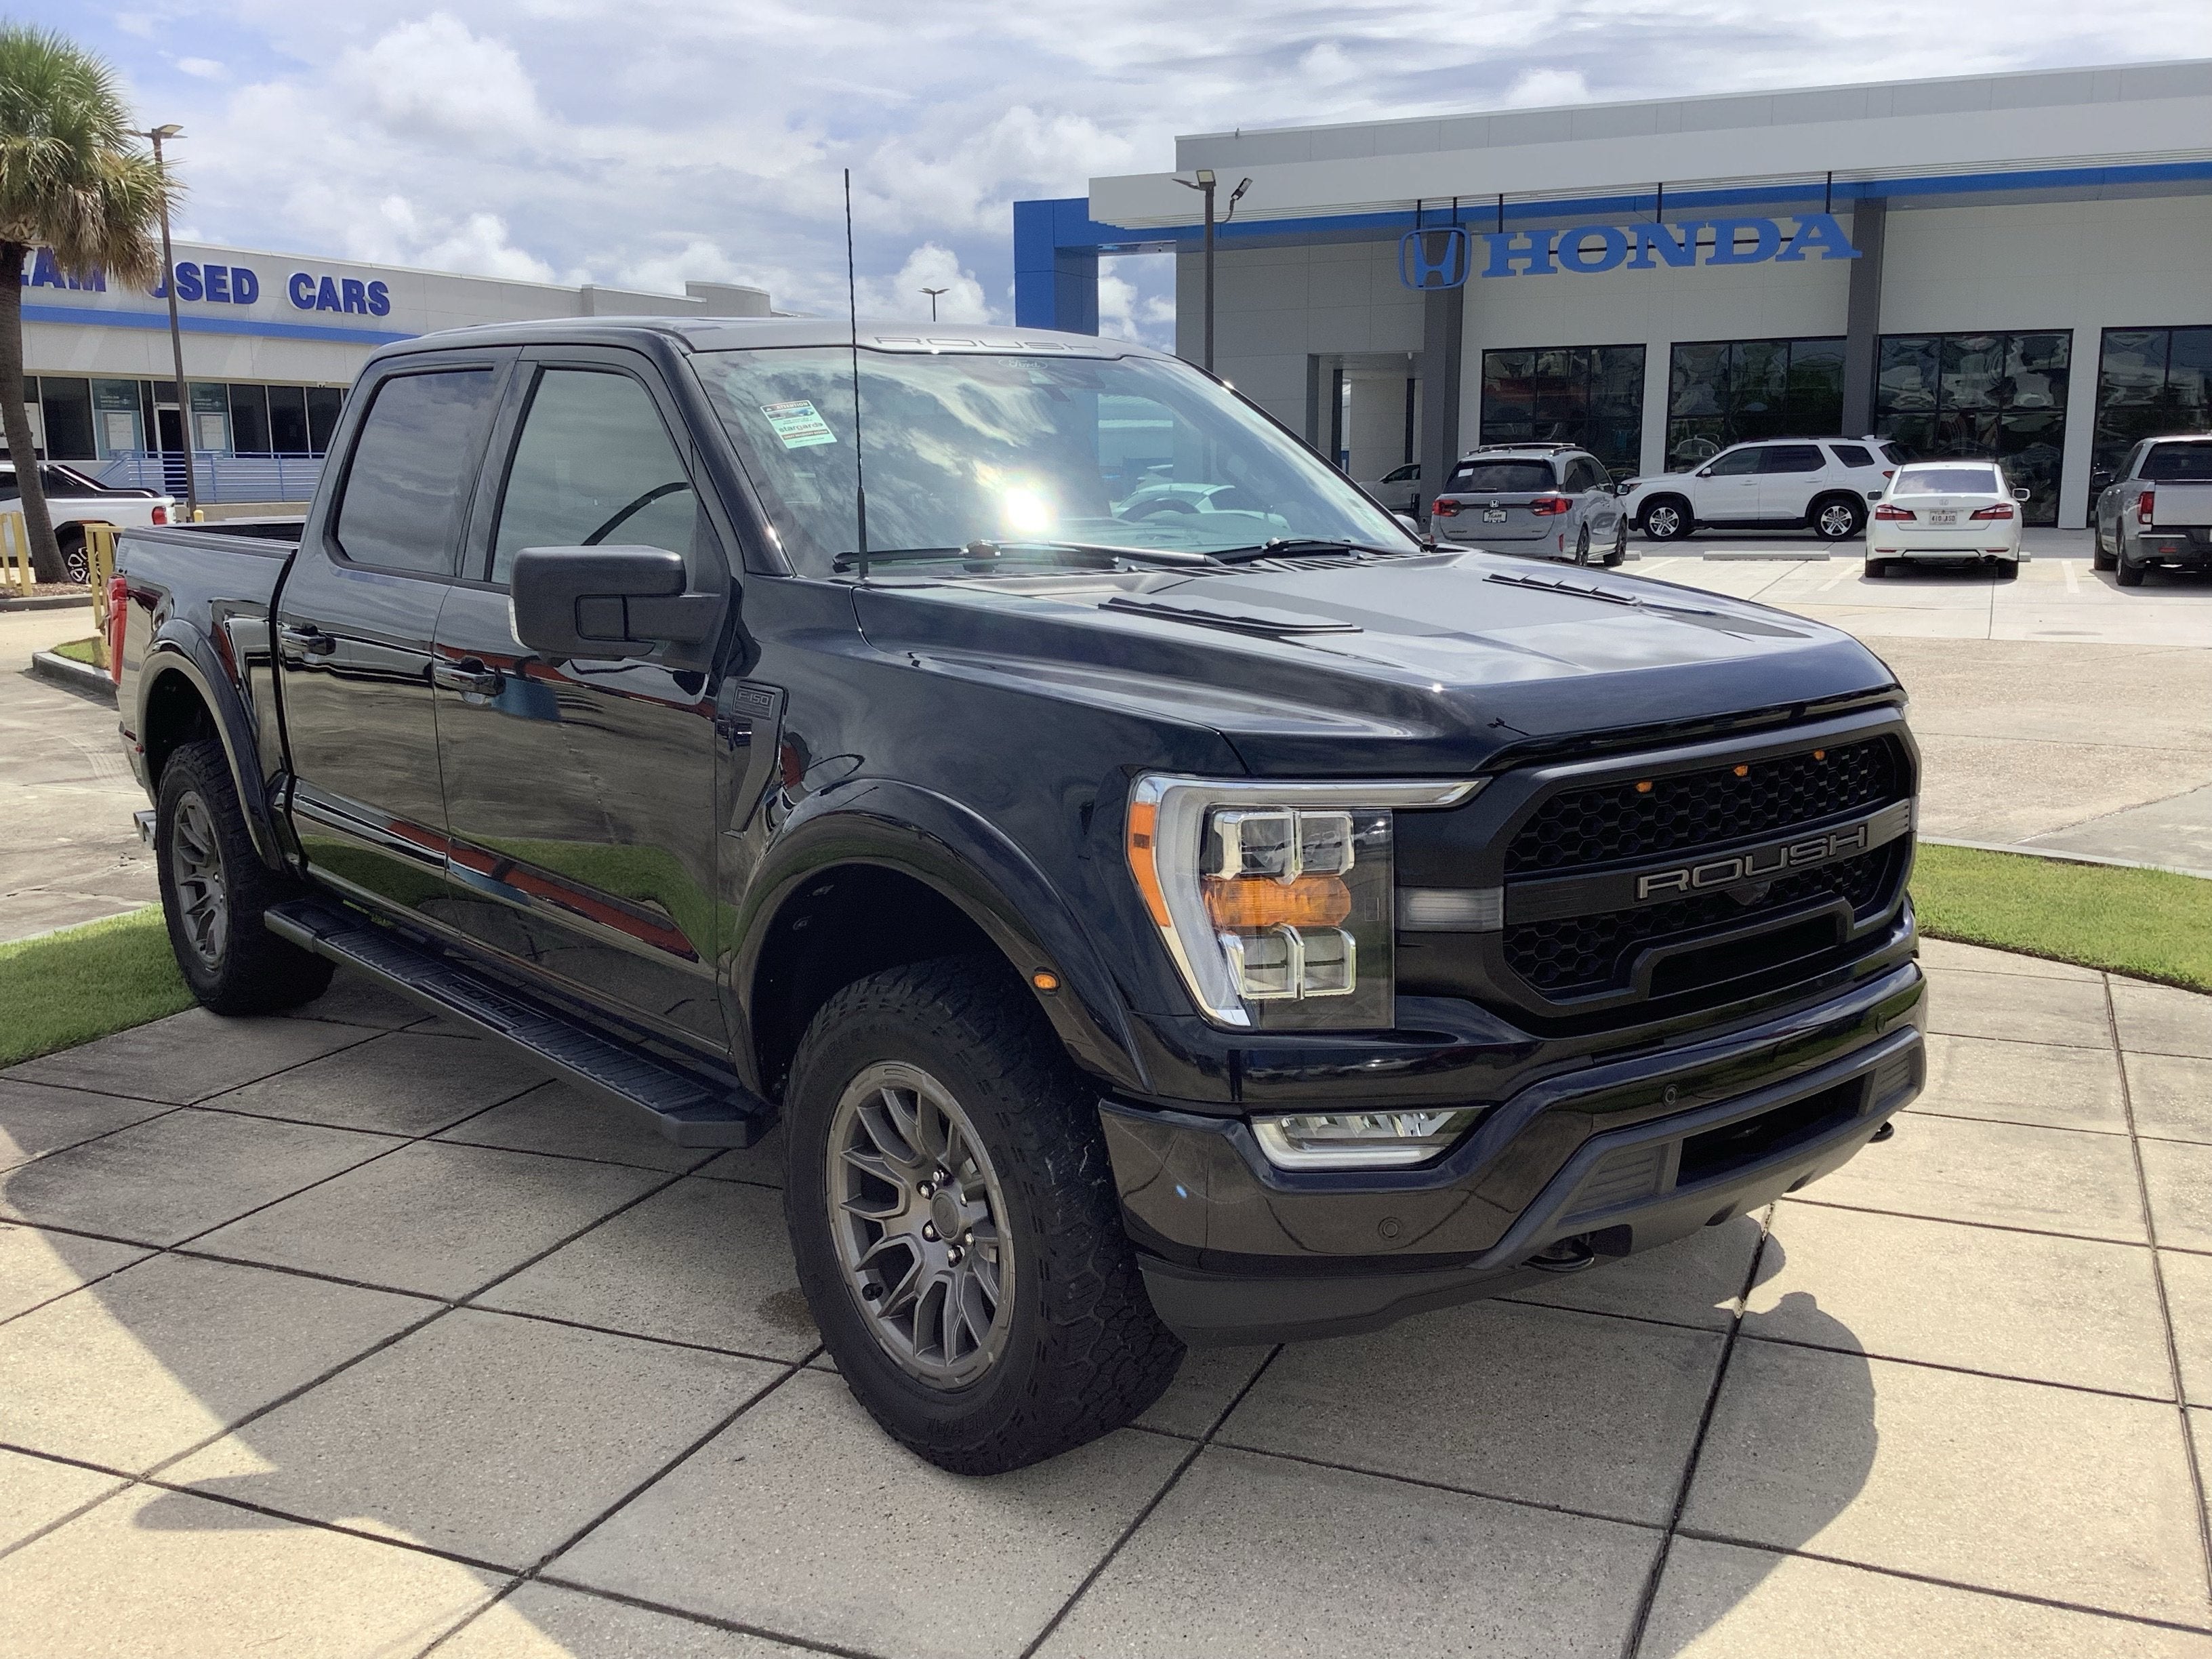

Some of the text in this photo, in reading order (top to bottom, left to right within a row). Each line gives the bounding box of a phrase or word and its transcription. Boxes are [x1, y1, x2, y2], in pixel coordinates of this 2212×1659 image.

[1482, 213, 1862, 278] HONDA
[290, 272, 390, 316] CARS
[874, 336, 1102, 352] ROUSH
[1008, 359, 1041, 369] Ford
[776, 402, 808, 410] ATTENTION
[738, 691, 770, 705] F-150
[1635, 824, 1868, 901] ROUSH
